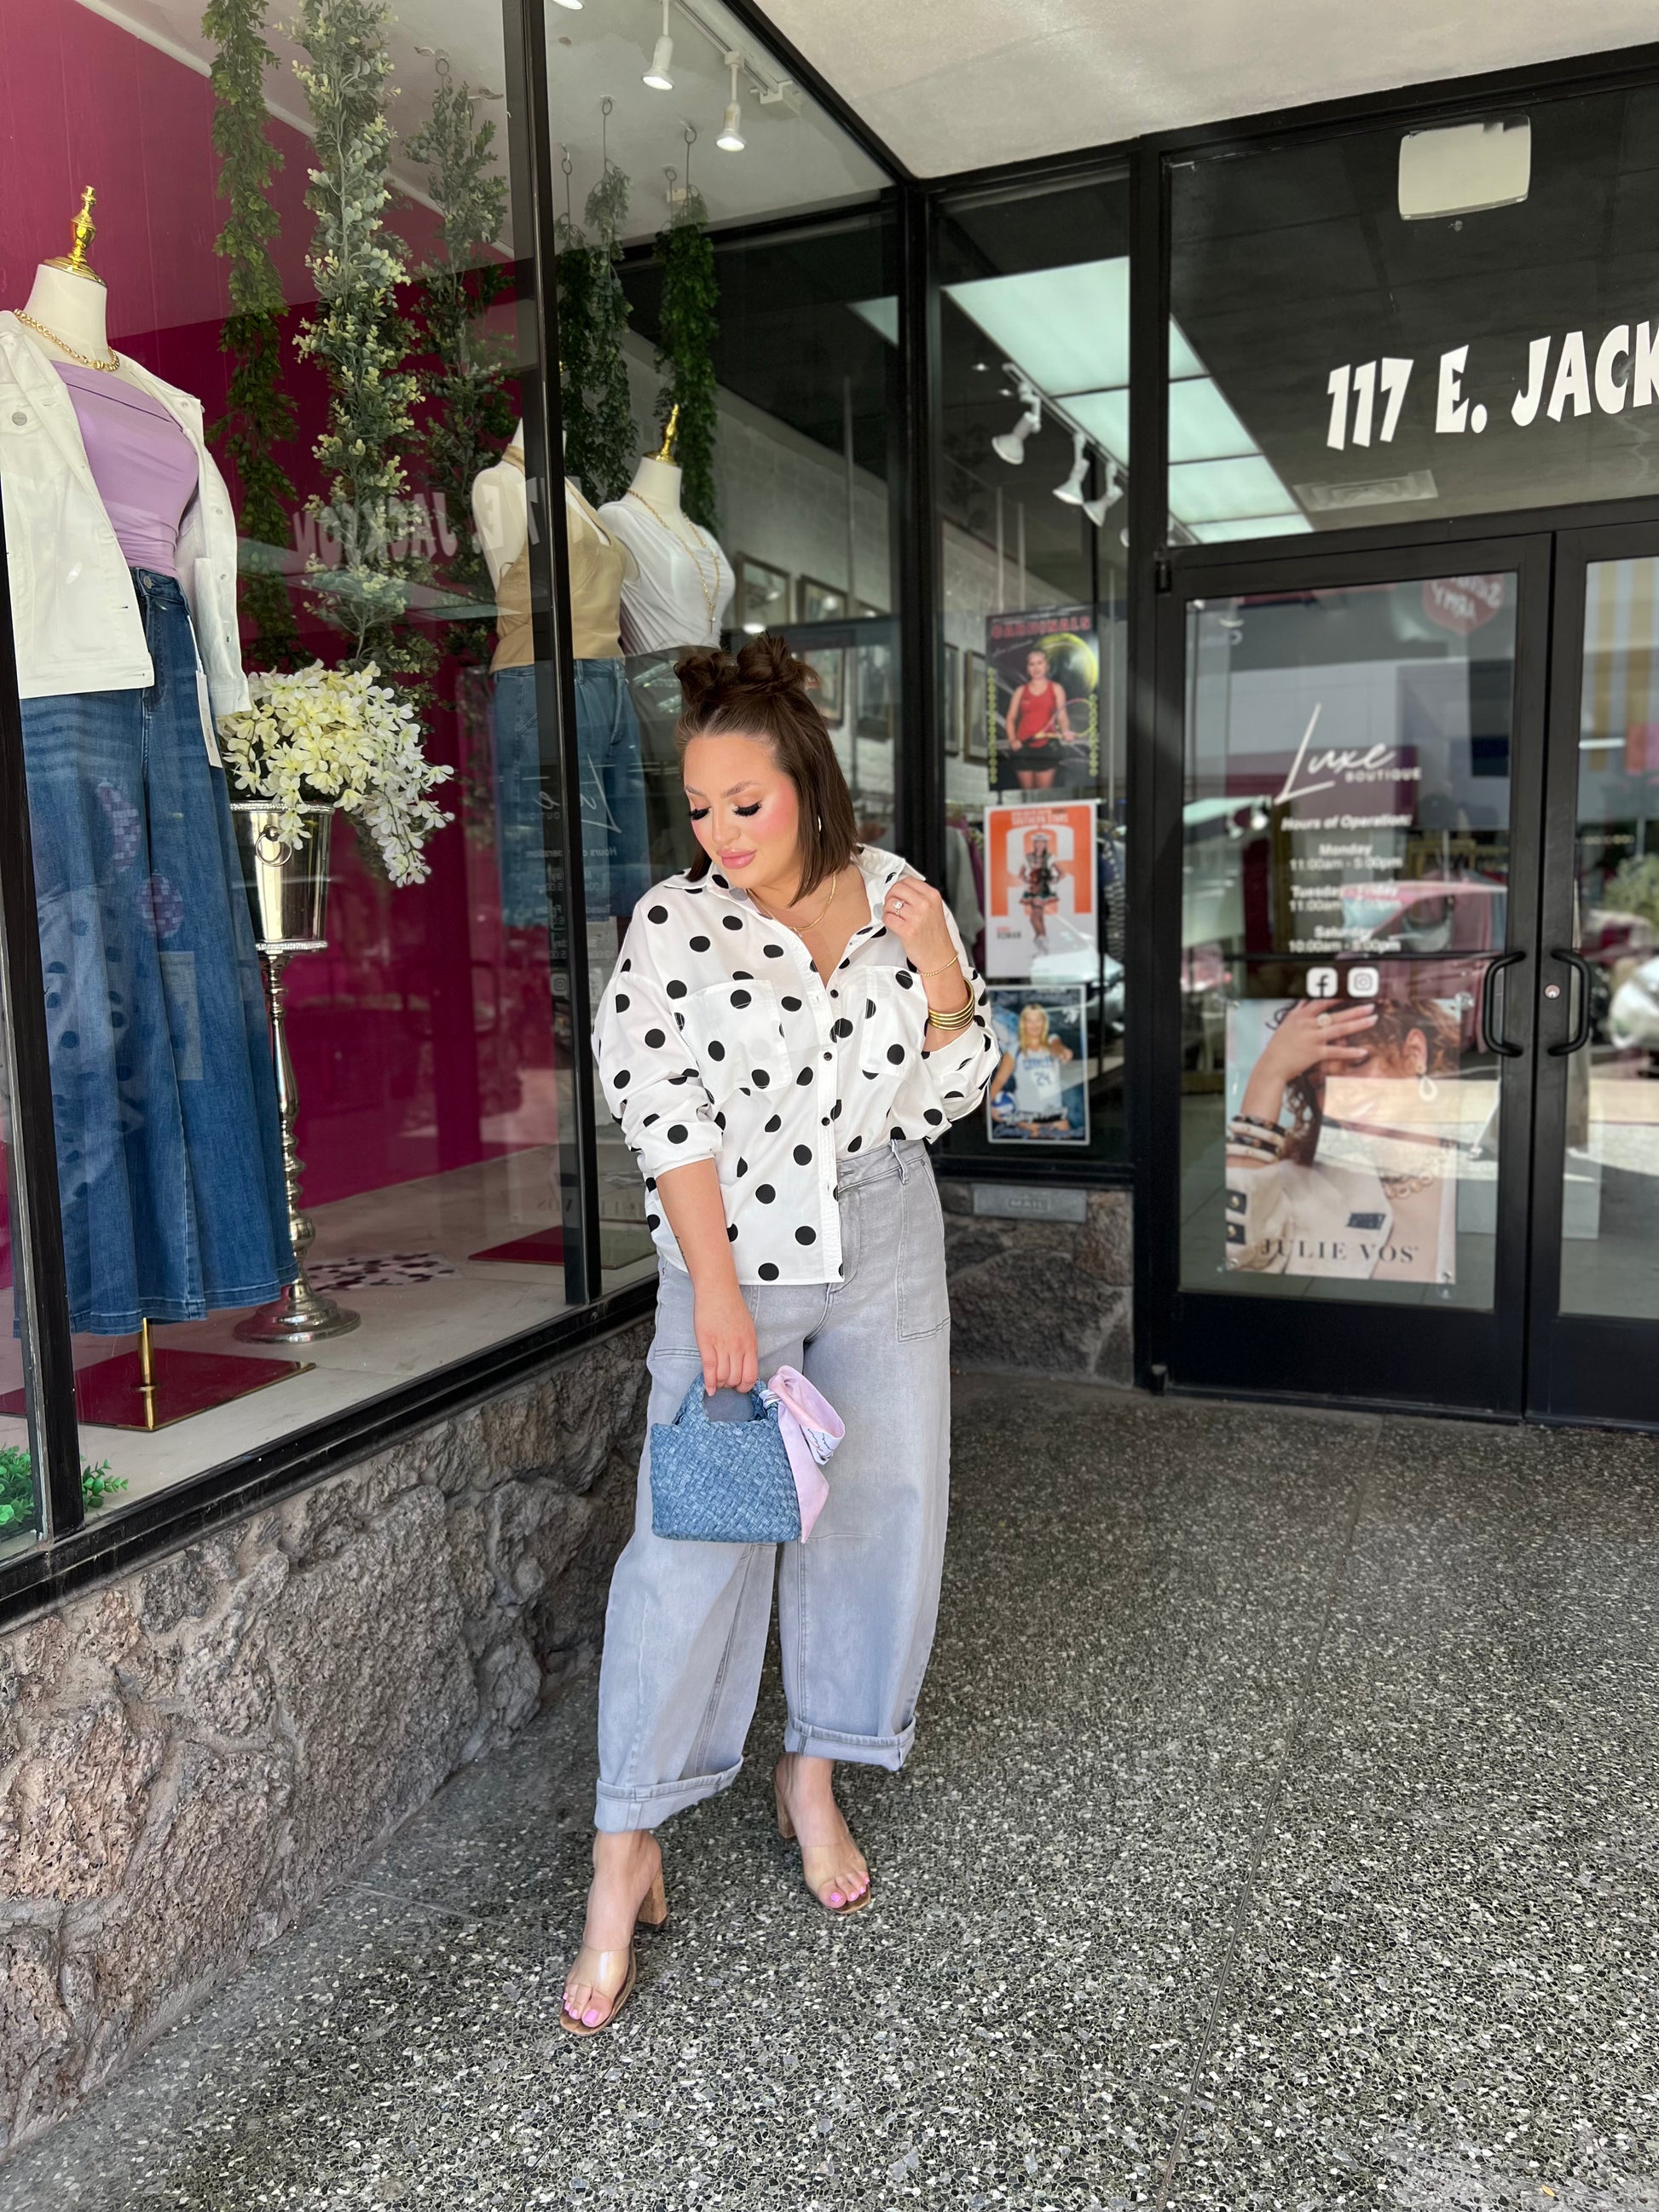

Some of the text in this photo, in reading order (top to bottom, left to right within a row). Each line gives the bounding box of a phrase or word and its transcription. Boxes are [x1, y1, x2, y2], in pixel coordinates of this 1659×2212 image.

[1327, 321, 1659, 450] 117 E. JACK
[1274, 702, 1396, 806] Luxe
[1344, 767, 1422, 783] BOUTIQUE
[1281, 817, 1321, 831] Hours
[1323, 816, 1339, 829] of
[1319, 843, 1373, 857] Monday
[1290, 858, 1344, 871] 11:00am
[1314, 926, 1373, 941] Saturday
[1289, 940, 1342, 954] 10:00am
[1009, 1198, 1045, 1210] MAIL
[1260, 1239, 1413, 1263] JULIE VOS
